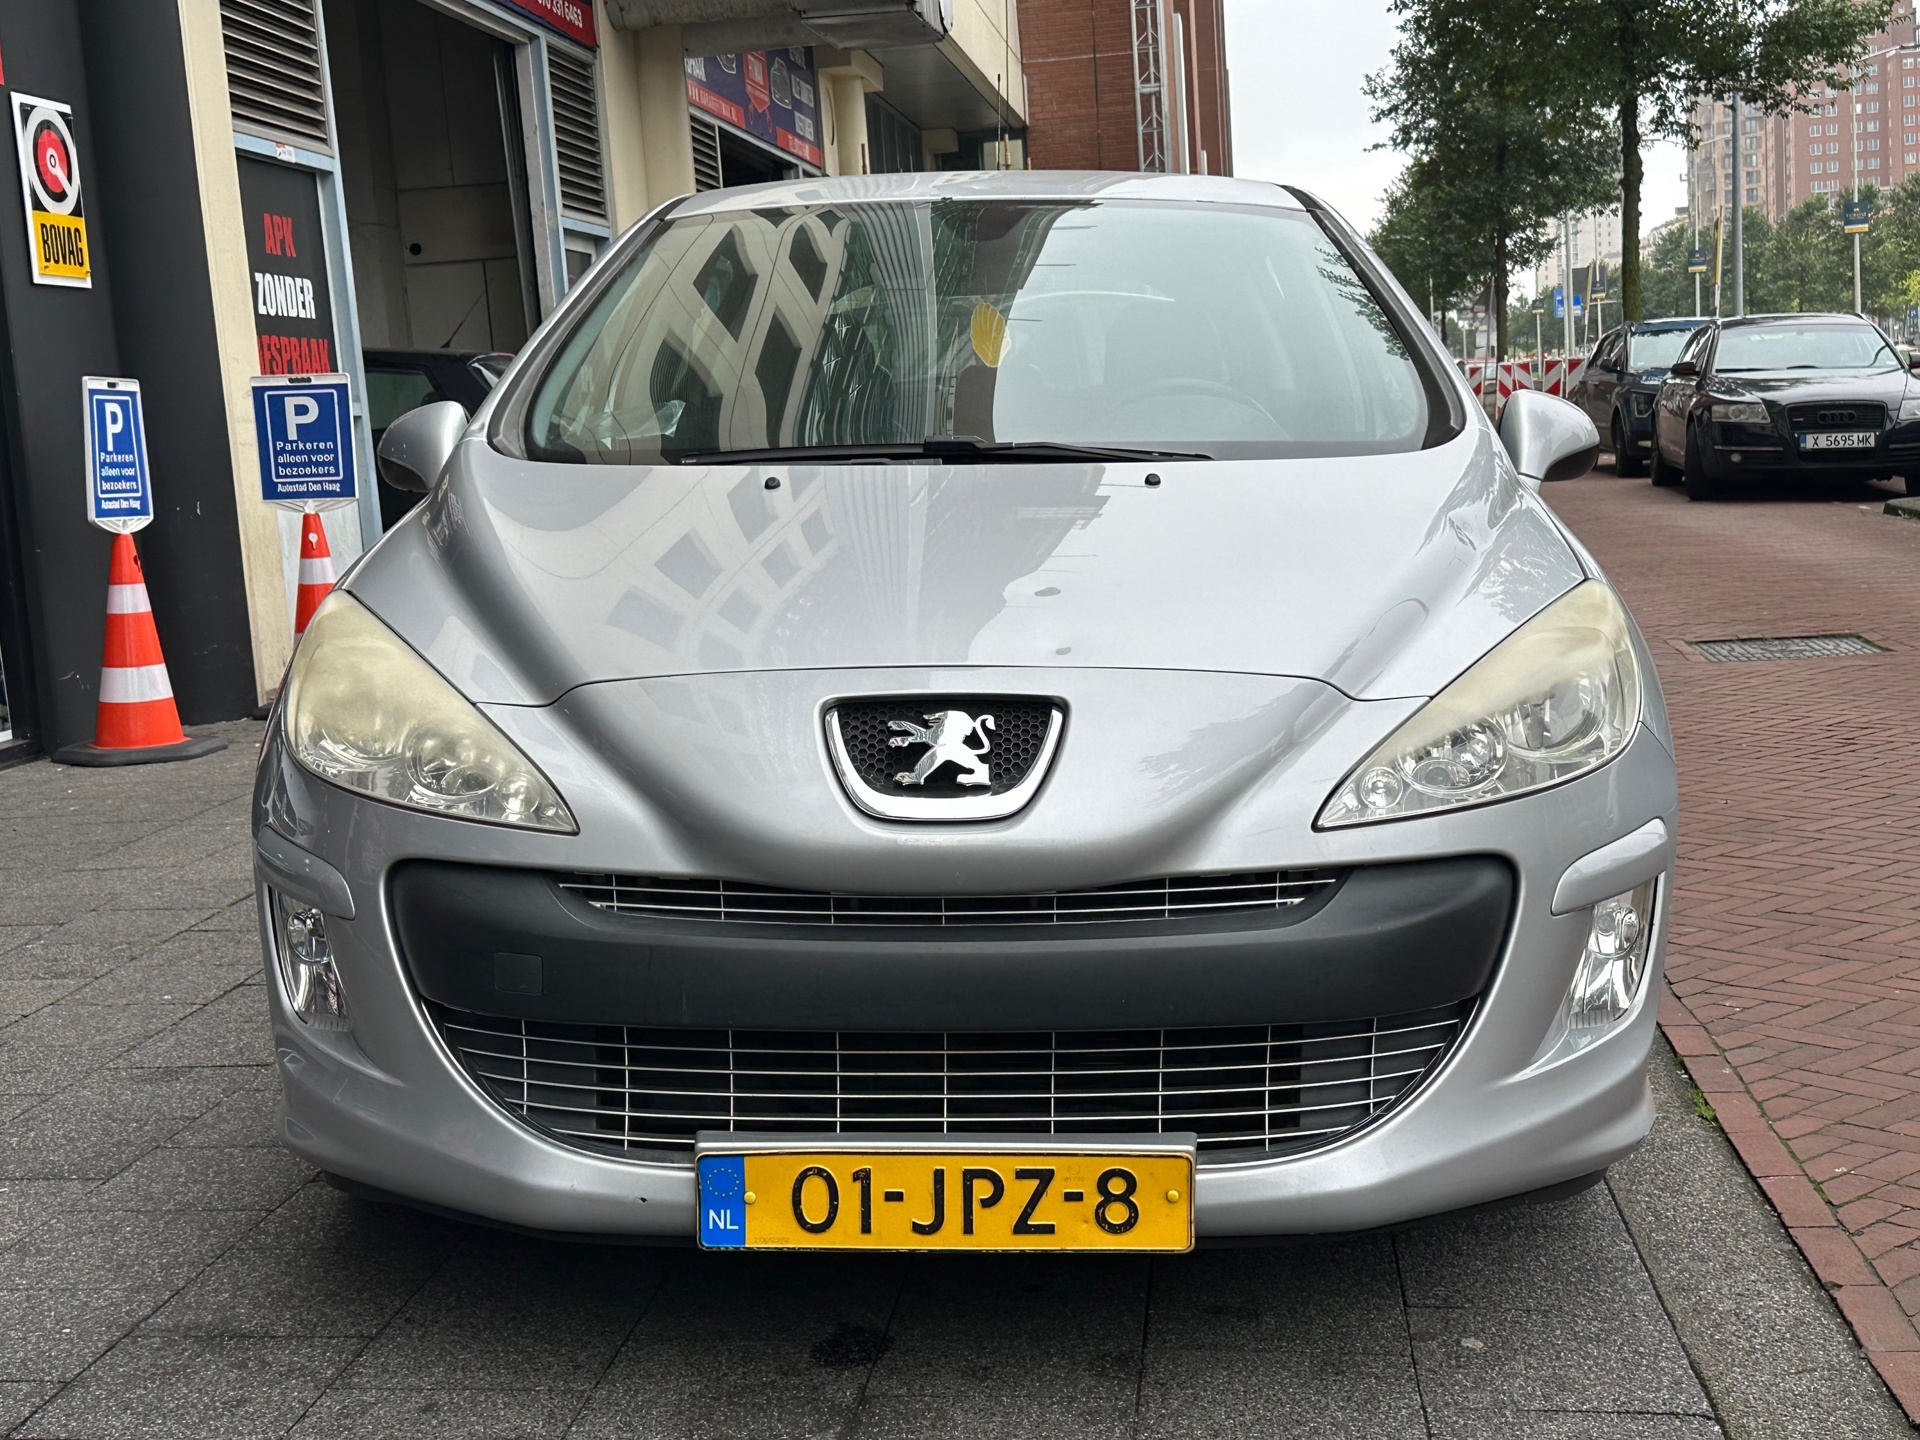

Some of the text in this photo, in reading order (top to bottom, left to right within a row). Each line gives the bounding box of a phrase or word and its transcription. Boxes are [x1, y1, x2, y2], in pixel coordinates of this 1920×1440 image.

[263, 212, 297, 258] APK
[40, 222, 85, 268] BOVAG
[254, 271, 316, 320] ZONDER
[283, 396, 319, 441] P
[104, 402, 123, 452] P
[276, 440, 334, 451] Parkeren
[1812, 433, 1872, 448] X 5695 MK
[100, 452, 134, 463] Parkeren
[277, 453, 335, 464] alleen voor
[101, 465, 136, 477] alleen voor
[278, 465, 336, 476] bezoekers
[101, 480, 138, 491] bezoekers
[308, 482, 323, 492] Den
[322, 481, 341, 492] Haag
[791, 1165, 1140, 1236] 01-JPZ-8
[708, 1208, 739, 1230] NL
